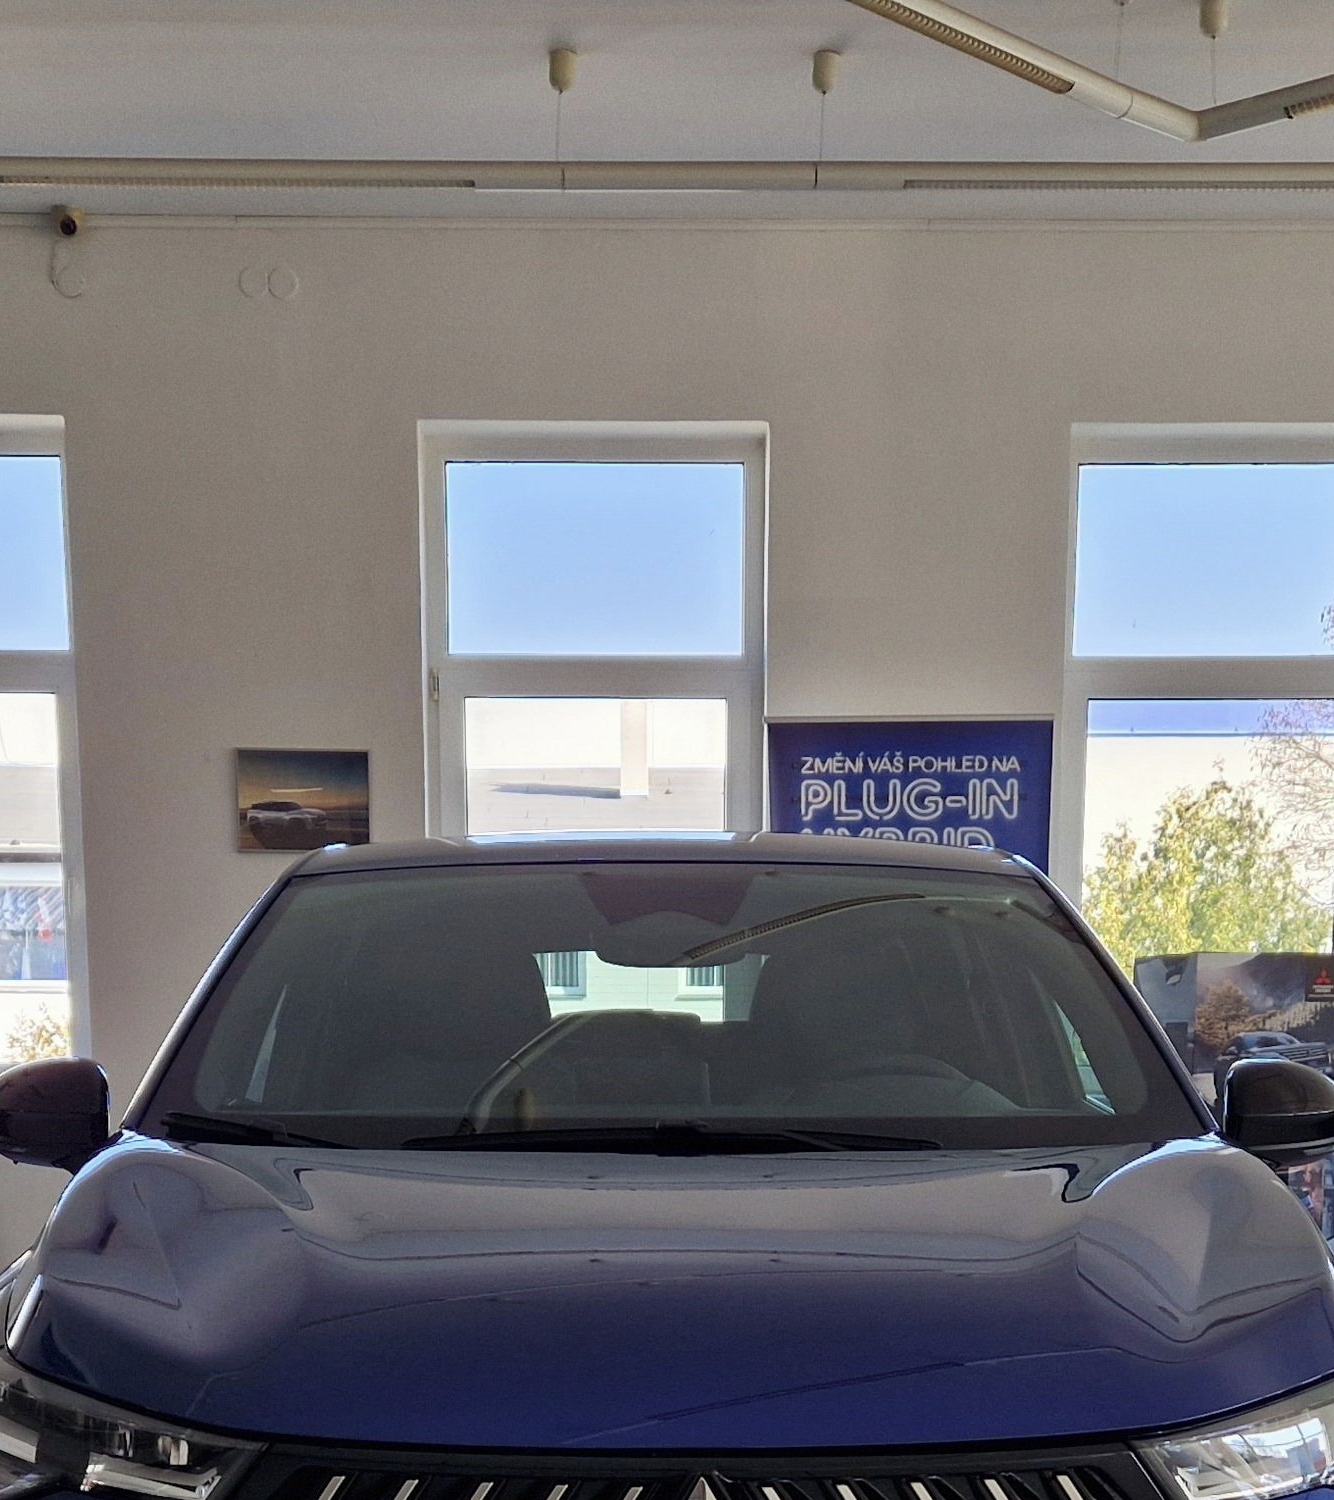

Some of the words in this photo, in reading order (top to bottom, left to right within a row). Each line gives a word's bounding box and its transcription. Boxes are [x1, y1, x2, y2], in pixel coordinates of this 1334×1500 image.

[801, 752, 864, 774] ZMĚNÍ
[868, 751, 904, 774] VÁŠ
[908, 756, 988, 773] POHLED
[992, 756, 1021, 773] NA
[801, 778, 1018, 821] PLUG-IN
